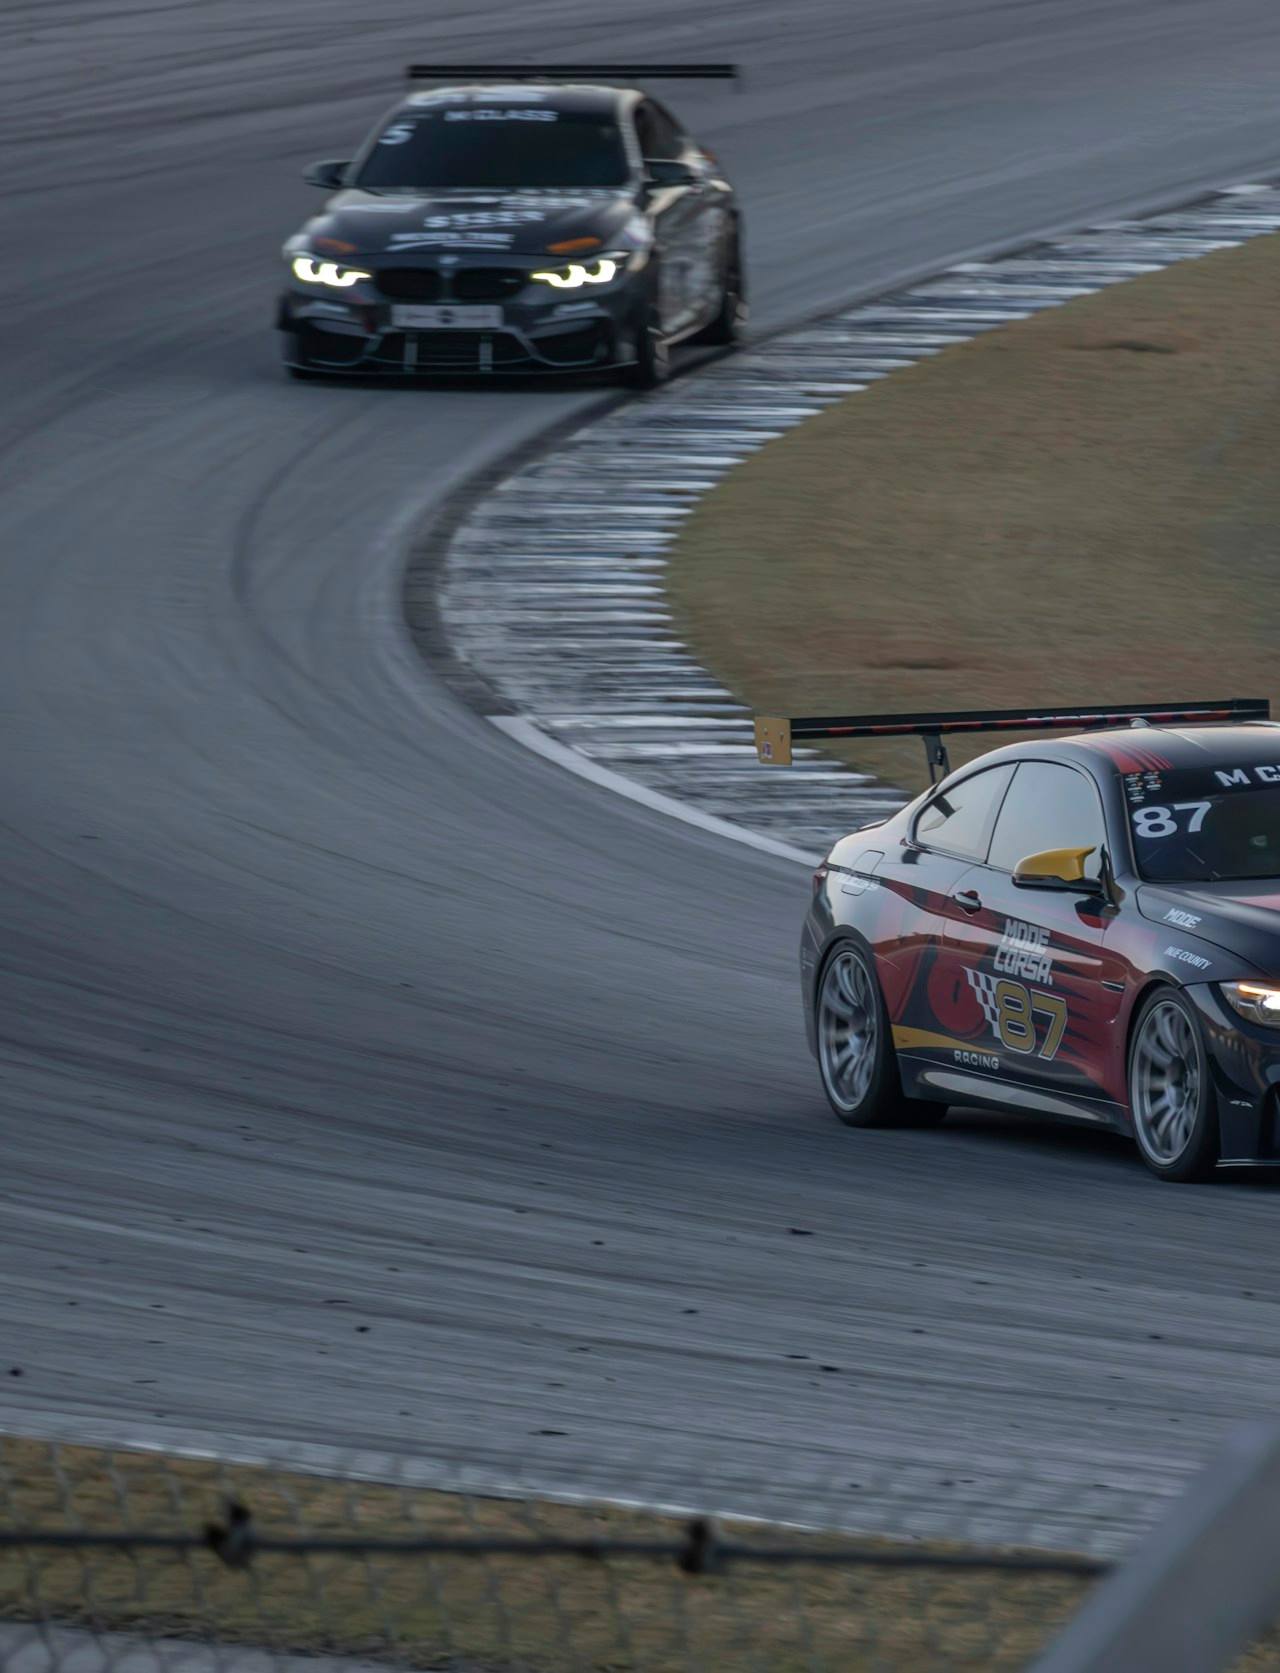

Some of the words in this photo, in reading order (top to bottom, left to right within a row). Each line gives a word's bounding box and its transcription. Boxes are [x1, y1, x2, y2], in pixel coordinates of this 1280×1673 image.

[1214, 768, 1250, 787] M
[1132, 801, 1212, 839] 87
[1001, 918, 1050, 955] MODE
[996, 978, 1068, 1061] 87
[953, 1049, 1000, 1070] RACING
